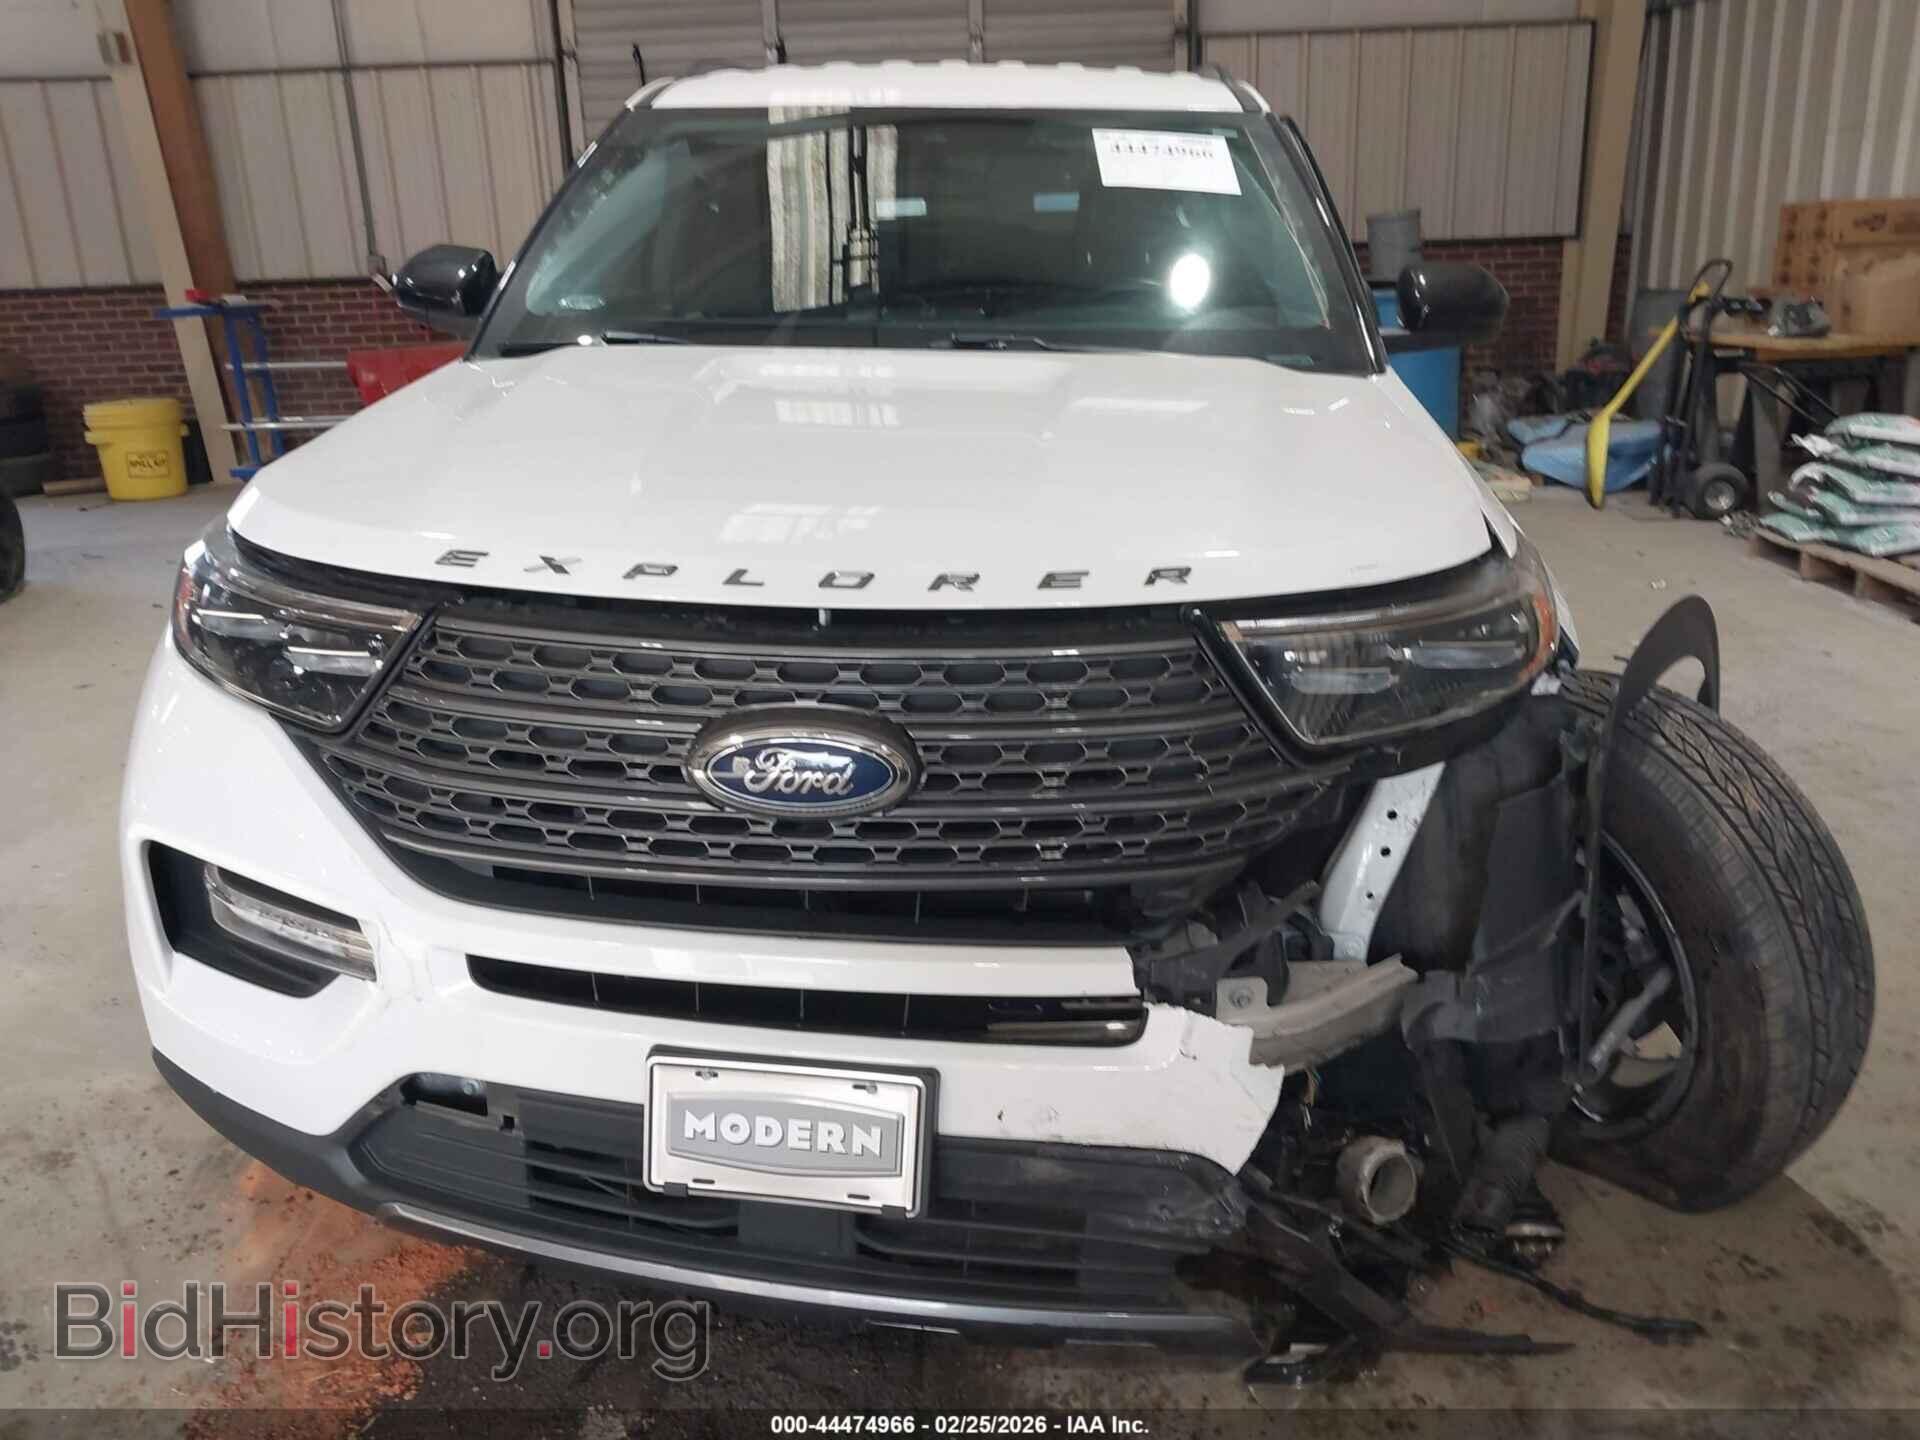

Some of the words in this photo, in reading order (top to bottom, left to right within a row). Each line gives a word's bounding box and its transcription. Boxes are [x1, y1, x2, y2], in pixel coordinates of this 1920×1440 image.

[434, 549, 1193, 592] EXPLORER
[743, 747, 856, 795] Ford
[683, 1109, 882, 1157] MODERN
